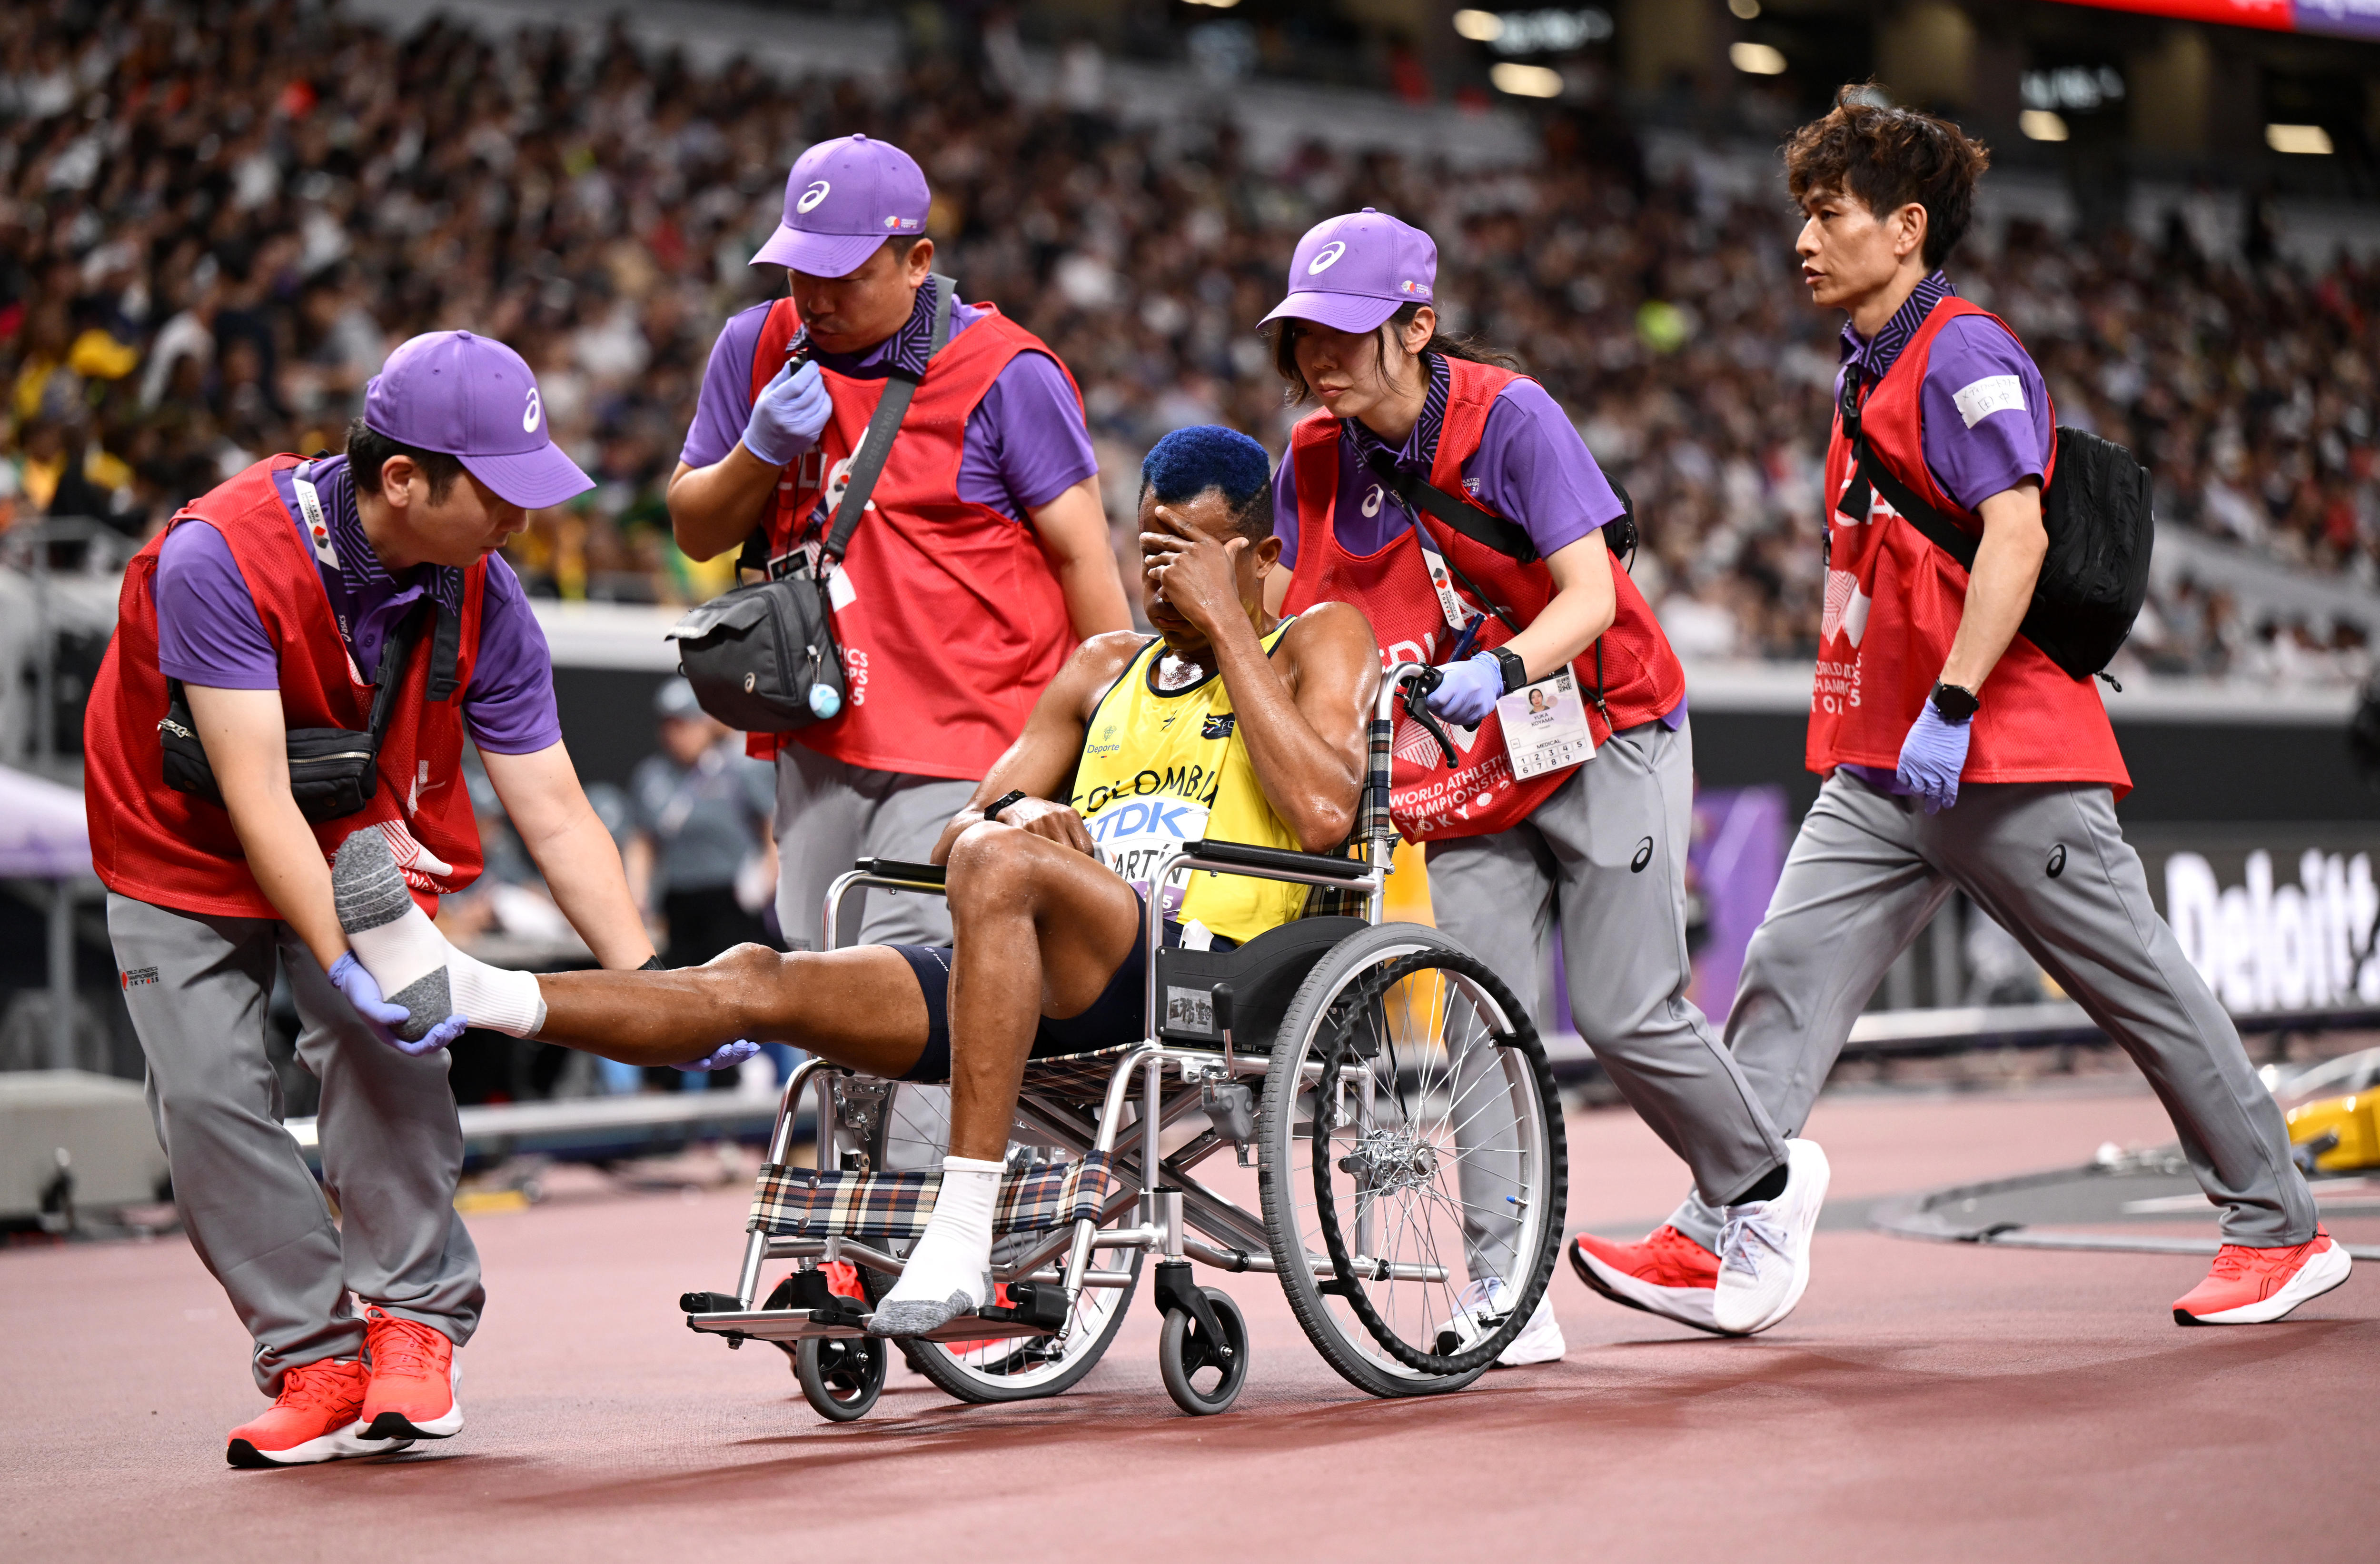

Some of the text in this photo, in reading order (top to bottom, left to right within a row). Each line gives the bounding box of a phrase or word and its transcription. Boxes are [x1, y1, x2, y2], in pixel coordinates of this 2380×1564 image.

[1531, 717, 1554, 727] KOYAMA
[1087, 744, 1120, 754] Deporte
[1537, 739, 1561, 749] MEDICAL
[1389, 751, 1509, 808] WORLD ATHLETIC
[1096, 802, 1189, 842] TDK
